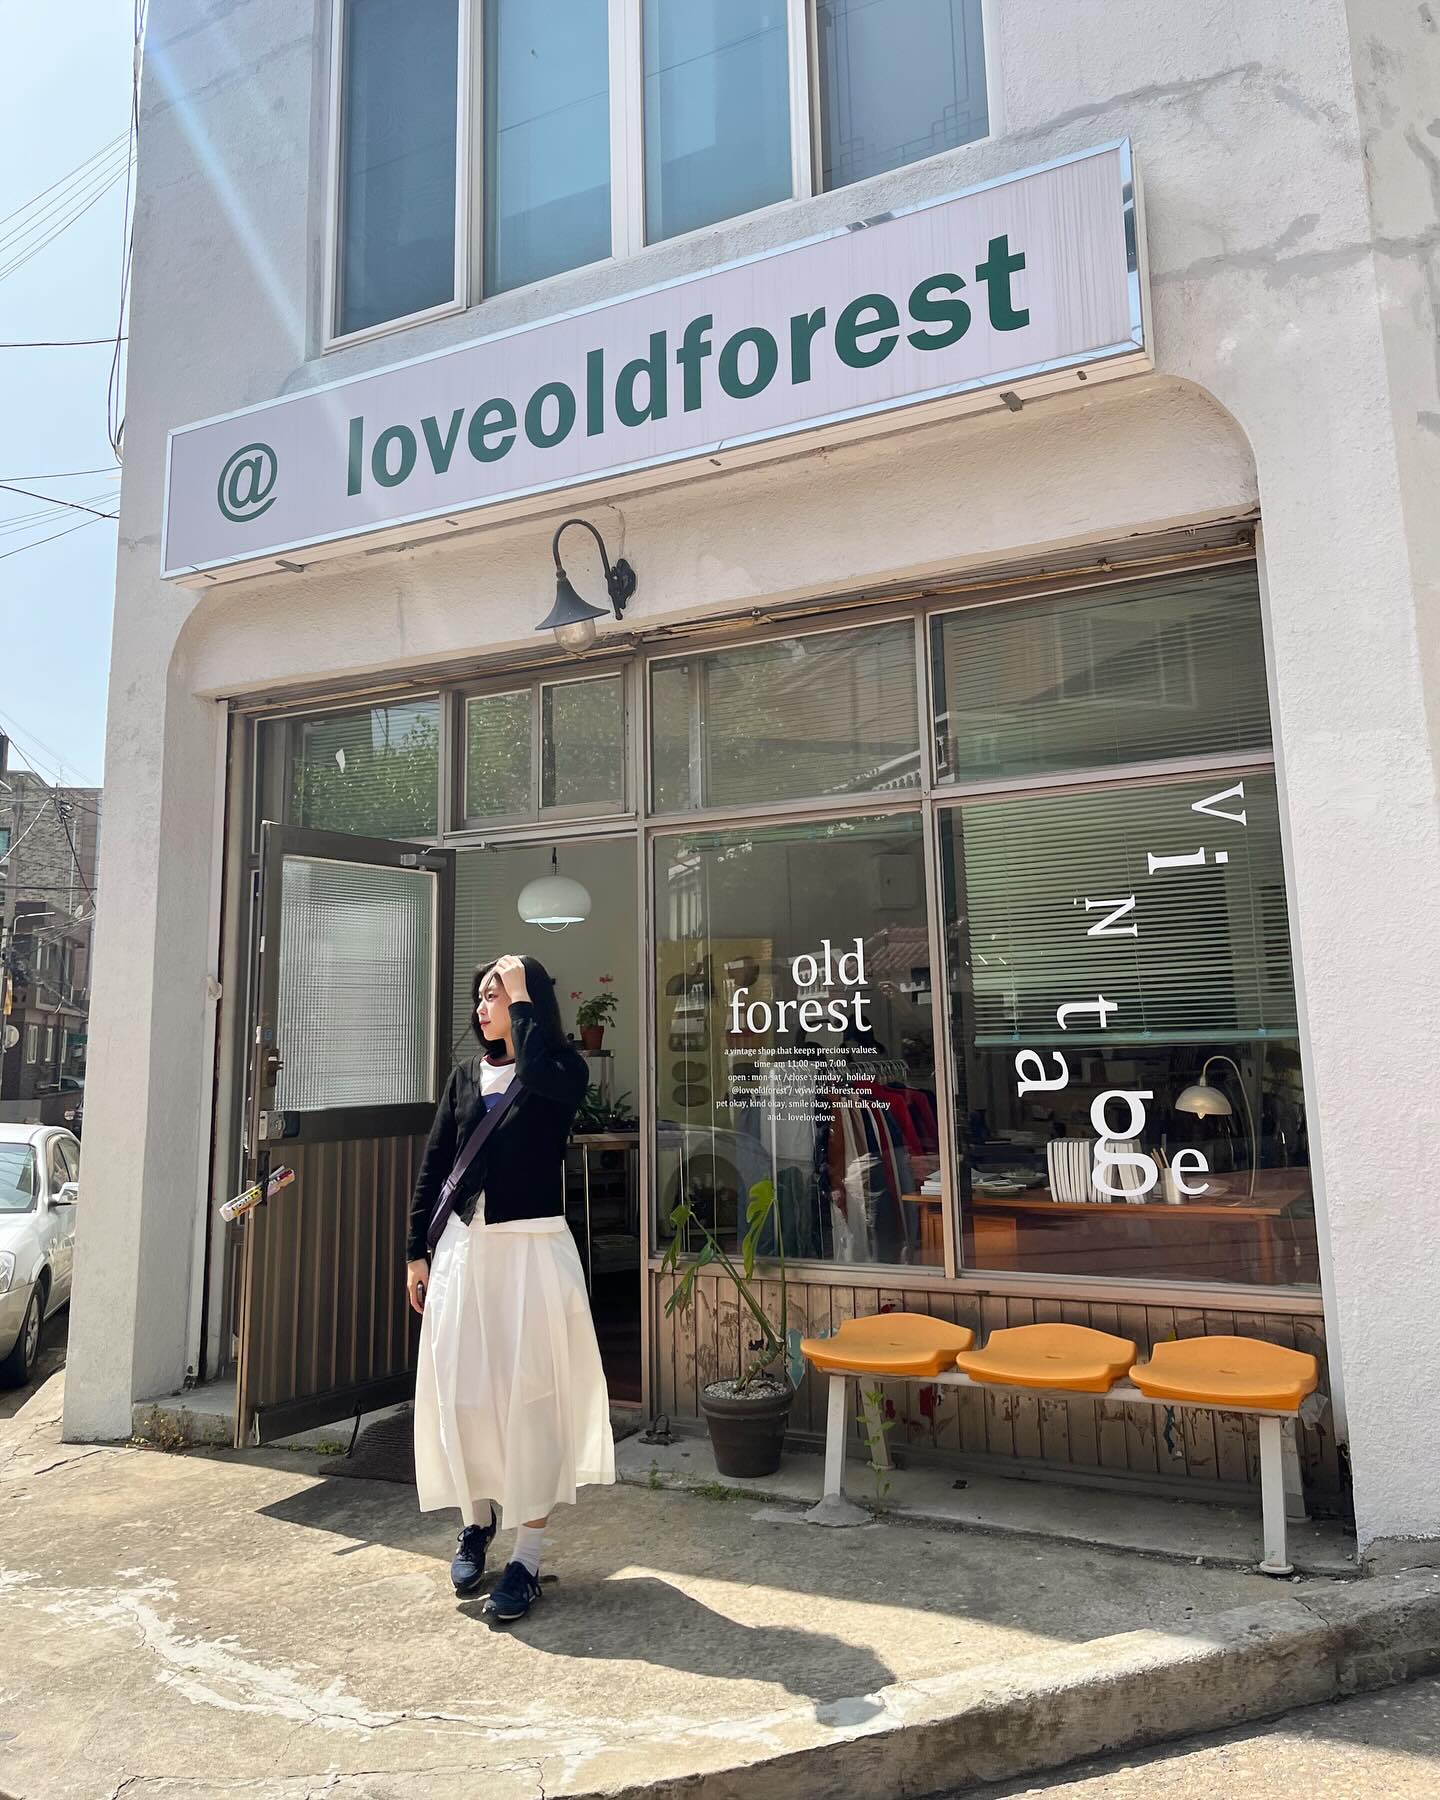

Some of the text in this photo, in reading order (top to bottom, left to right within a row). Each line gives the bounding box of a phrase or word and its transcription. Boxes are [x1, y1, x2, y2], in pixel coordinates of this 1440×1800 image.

[217, 234, 1031, 523] @ loveoldforest
[792, 938, 868, 987] old
[729, 987, 872, 1034] forest
[729, 1047, 756, 1056] vintage
[758, 1046, 776, 1056] shop
[777, 1046, 792, 1055] that
[793, 1046, 816, 1056] keeps
[816, 1046, 850, 1056] precious
[788, 1060, 809, 1068] 11:00
[829, 1059, 847, 1068] 7:00
[728, 1075, 746, 1083] open
[813, 1073, 843, 1082] sunday,
[846, 1073, 876, 1083] holiday
[731, 1085, 788, 1095] @loveoldforest
[794, 1086, 873, 1096] www.old-forest.com
[716, 1099, 891, 1110] pet okay, kind okay, smile okay, small talk okay
[788, 1113, 836, 1122] lovelovelove
